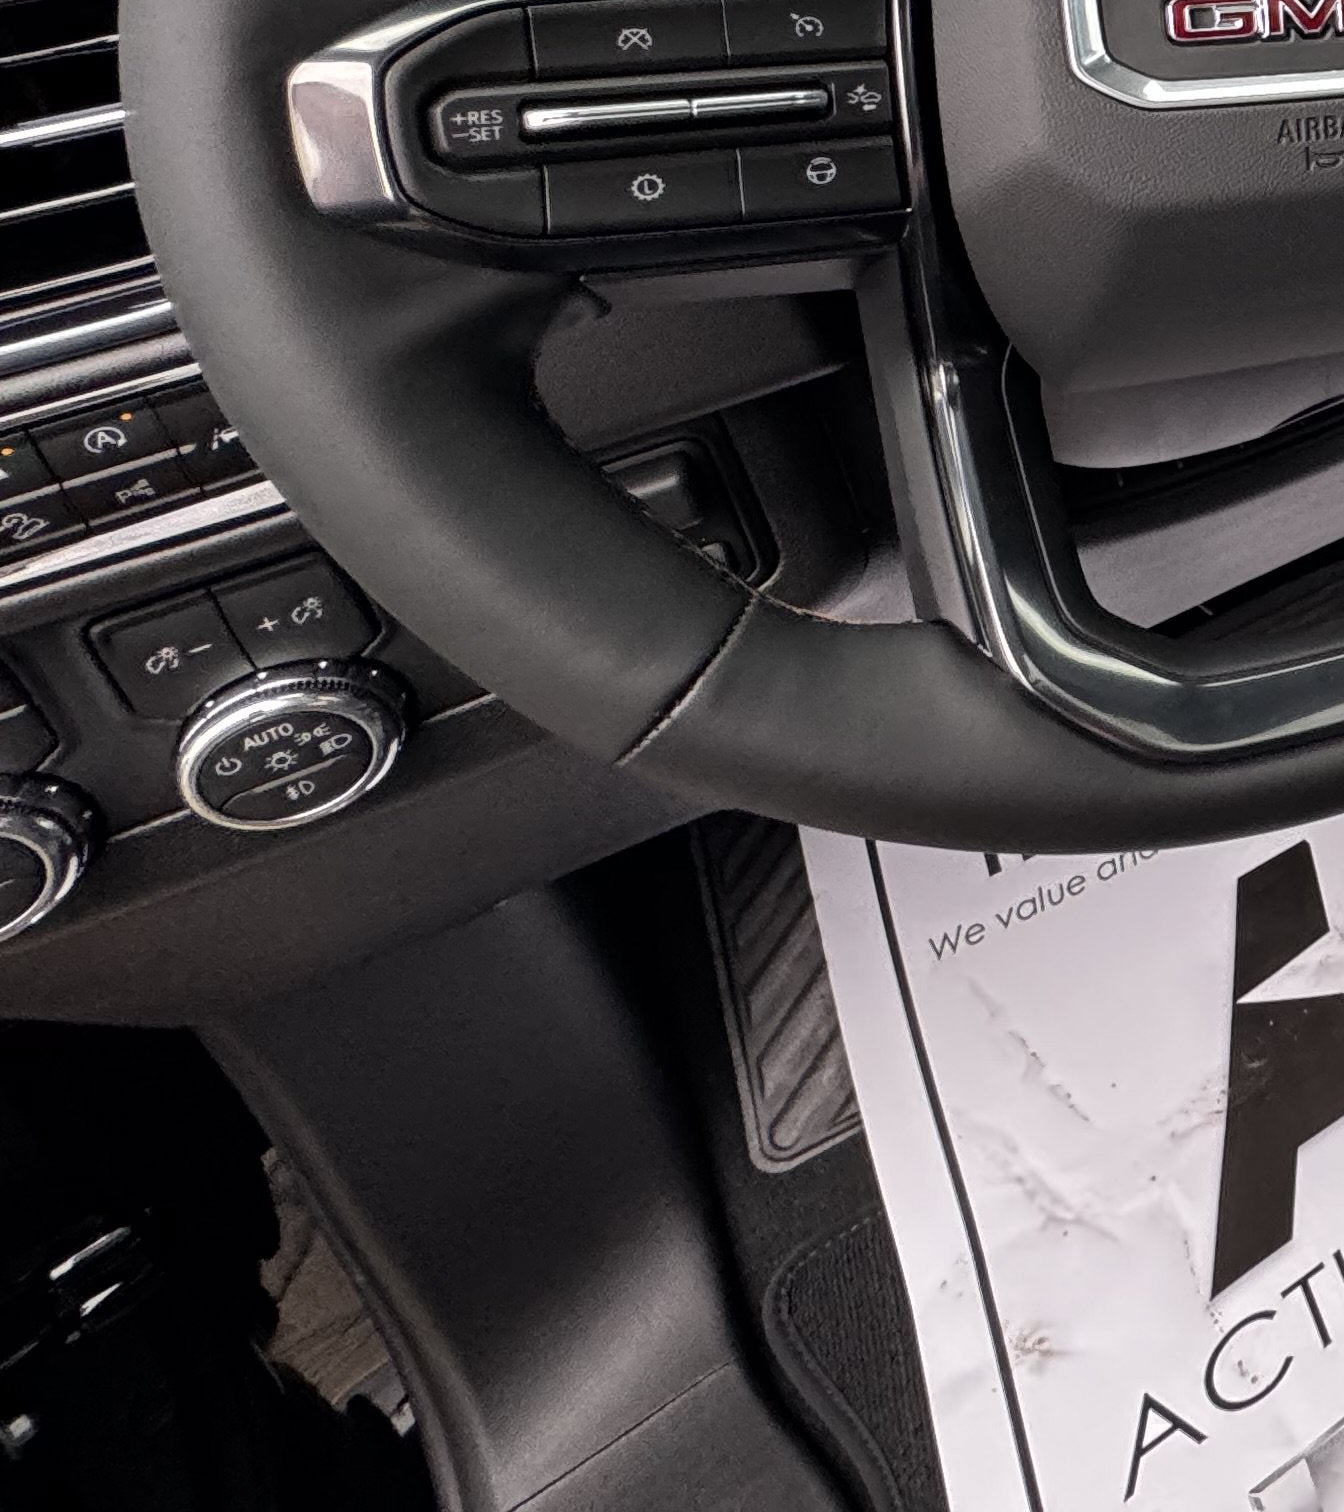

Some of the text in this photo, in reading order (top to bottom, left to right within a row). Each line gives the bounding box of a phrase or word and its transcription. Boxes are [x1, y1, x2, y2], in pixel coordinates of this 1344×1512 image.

[242, 722, 295, 752] AUTO
[928, 922, 986, 961] We
[995, 875, 1086, 929] value
